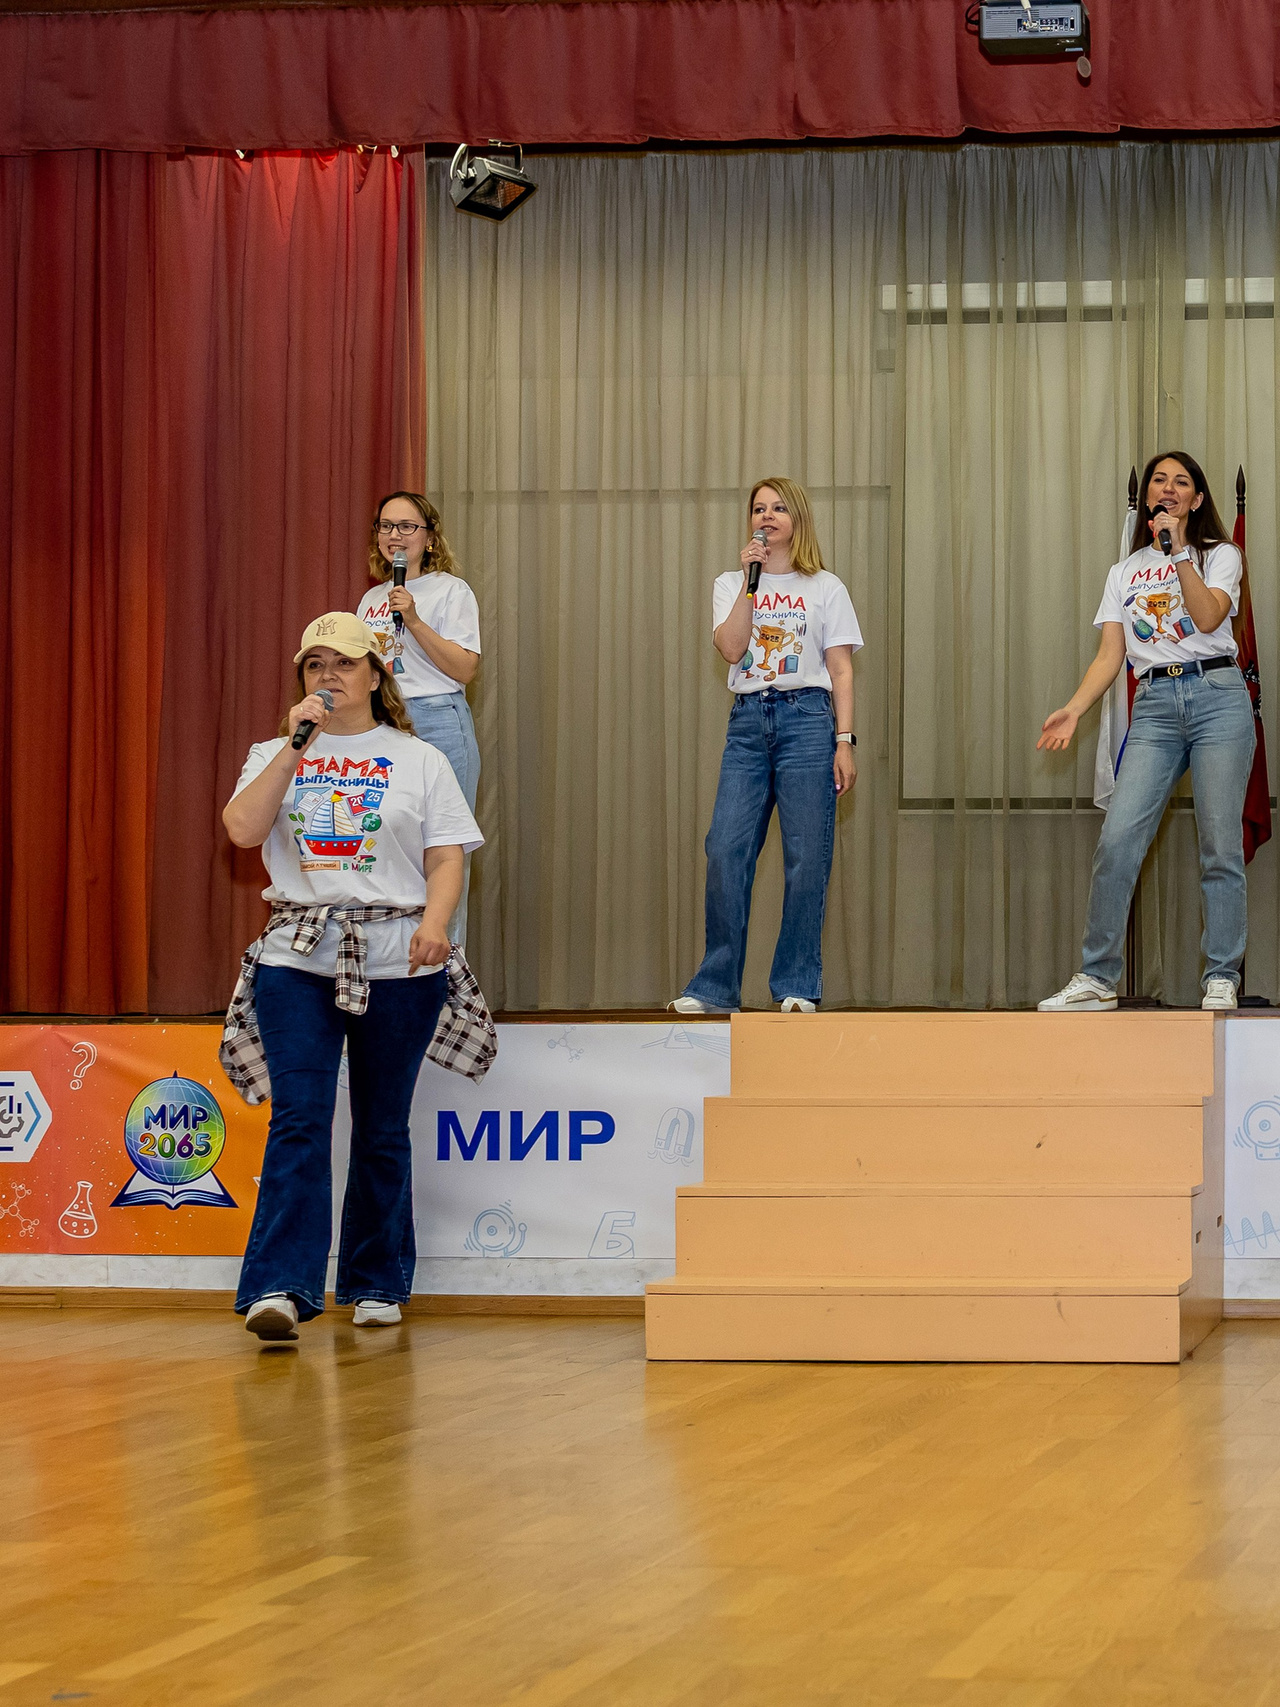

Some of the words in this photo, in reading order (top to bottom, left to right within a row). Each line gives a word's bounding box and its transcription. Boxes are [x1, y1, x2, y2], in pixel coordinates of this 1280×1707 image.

[1130, 563, 1178, 585] МАМ
[297, 756, 389, 779] МАМА
[366, 791, 381, 802] 25
[144, 1104, 209, 1131] МИР
[139, 1133, 212, 1159] 2065
[437, 1111, 615, 1161] МИР
